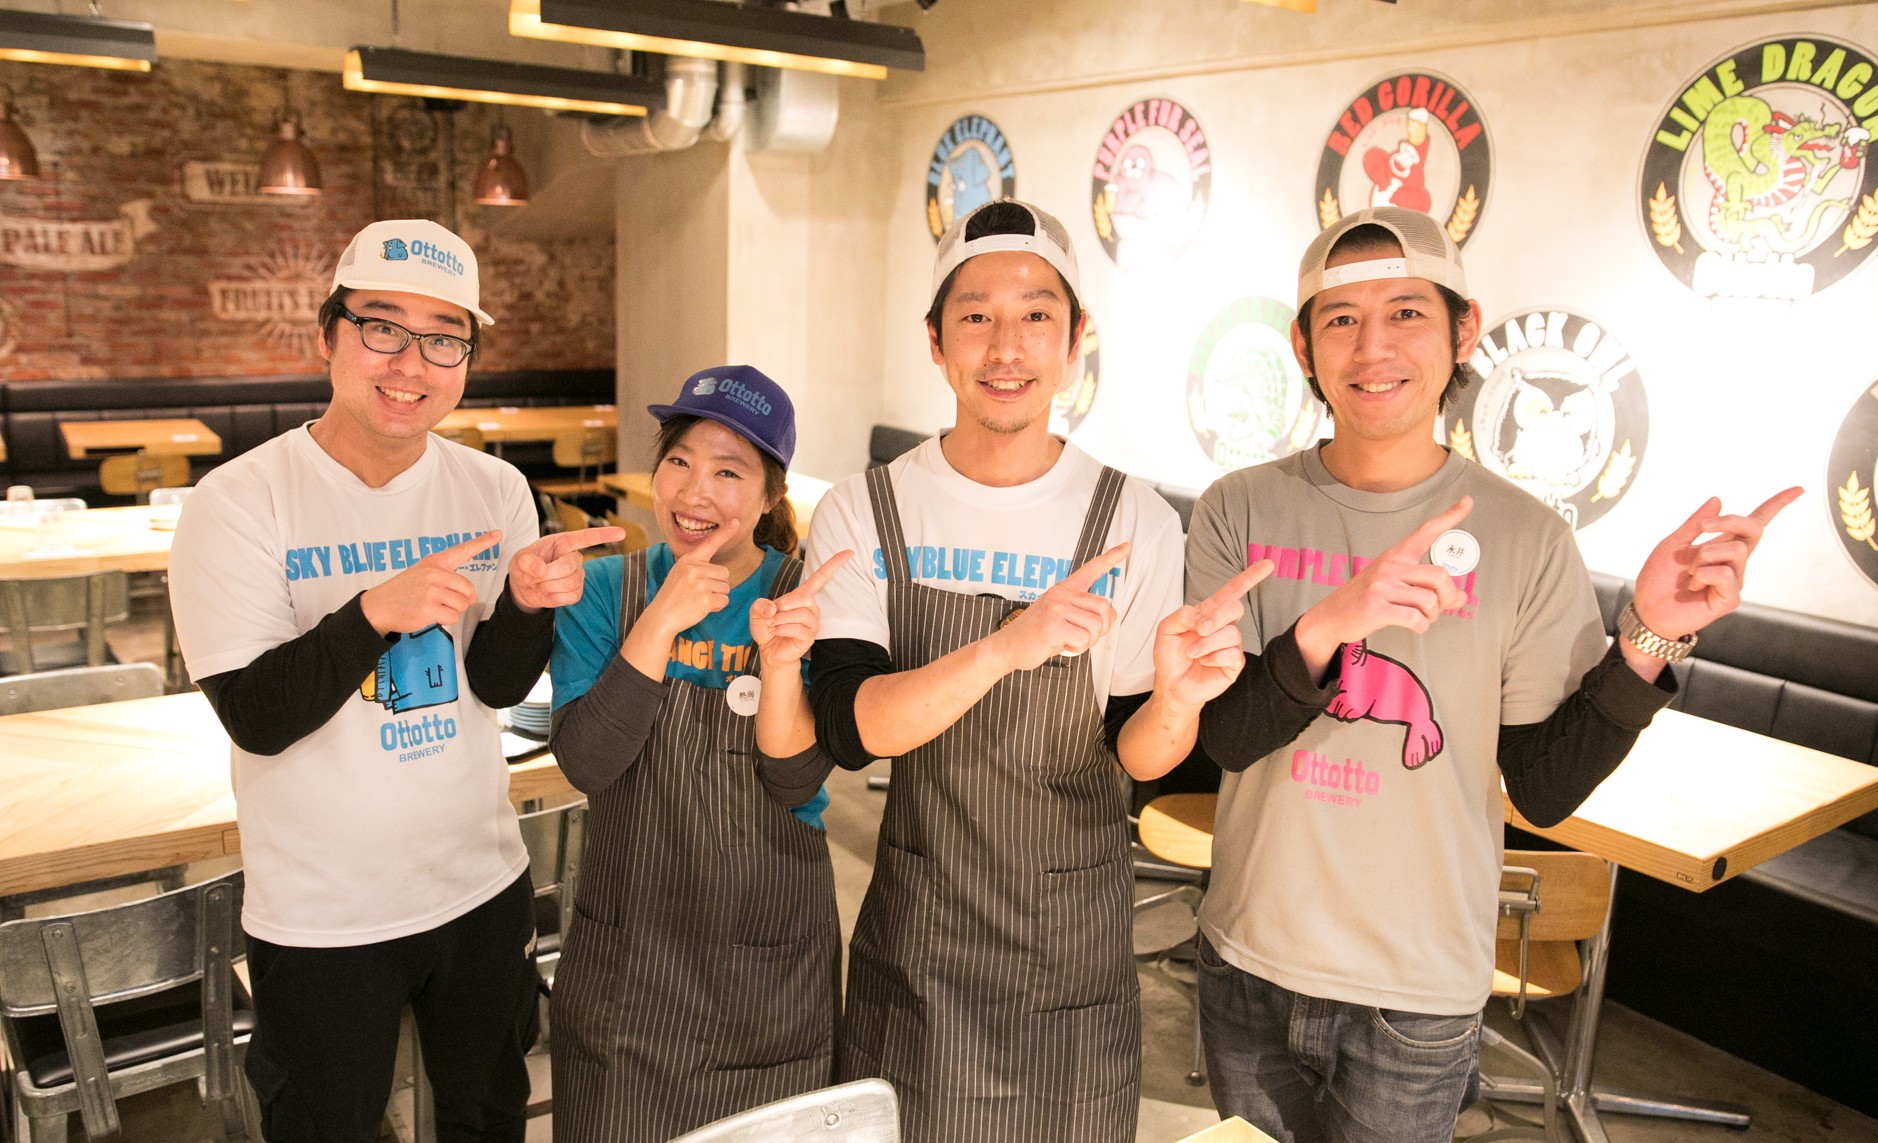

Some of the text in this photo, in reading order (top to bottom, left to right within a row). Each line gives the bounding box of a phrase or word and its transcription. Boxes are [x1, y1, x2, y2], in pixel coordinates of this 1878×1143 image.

[1327, 96, 1374, 156] RED
[1378, 75, 1482, 151] GORILLA
[1655, 58, 1745, 152] LIME
[1, 228, 126, 255] PALE ALE
[410, 239, 464, 277] Ottotto
[421, 258, 457, 278] BREWERY
[1469, 311, 1569, 380] BLACK
[718, 378, 772, 416] Ottotto
[725, 394, 760, 416] BREWERY
[286, 546, 332, 581] SKY
[337, 541, 387, 575] BLUE
[380, 712, 457, 751] Ottotto
[399, 744, 446, 763] BREWERY
[1291, 749, 1381, 796] Ottotto
[1304, 789, 1363, 808] BREWERY
